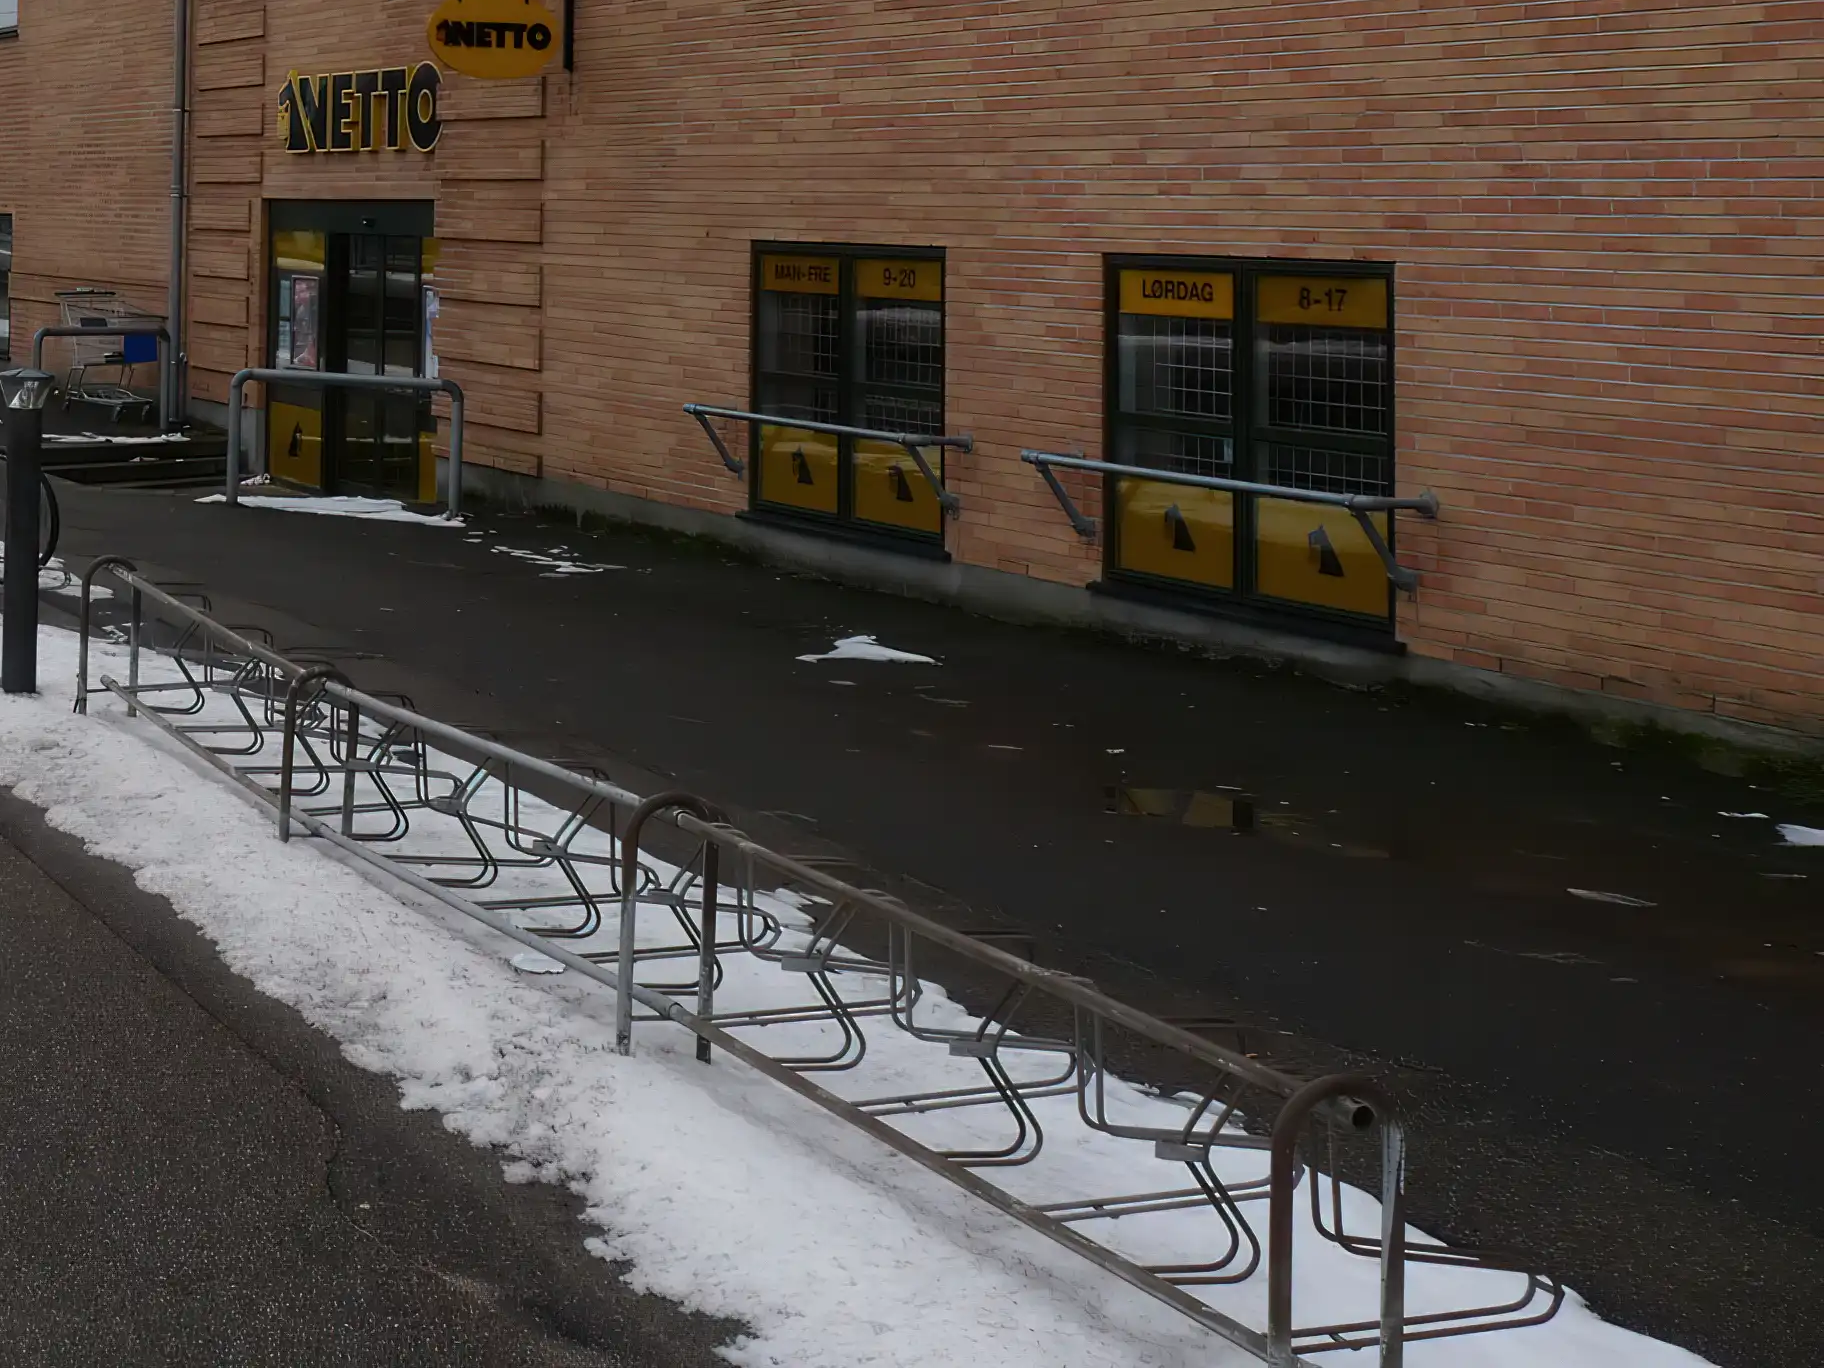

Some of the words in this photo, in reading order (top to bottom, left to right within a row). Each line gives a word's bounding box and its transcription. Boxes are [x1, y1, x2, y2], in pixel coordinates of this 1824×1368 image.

[437, 19, 552, 51] NETTO
[278, 60, 444, 153] NETTO
[774, 263, 832, 283] MAN-FRE
[1141, 278, 1214, 303] LØRDAG
